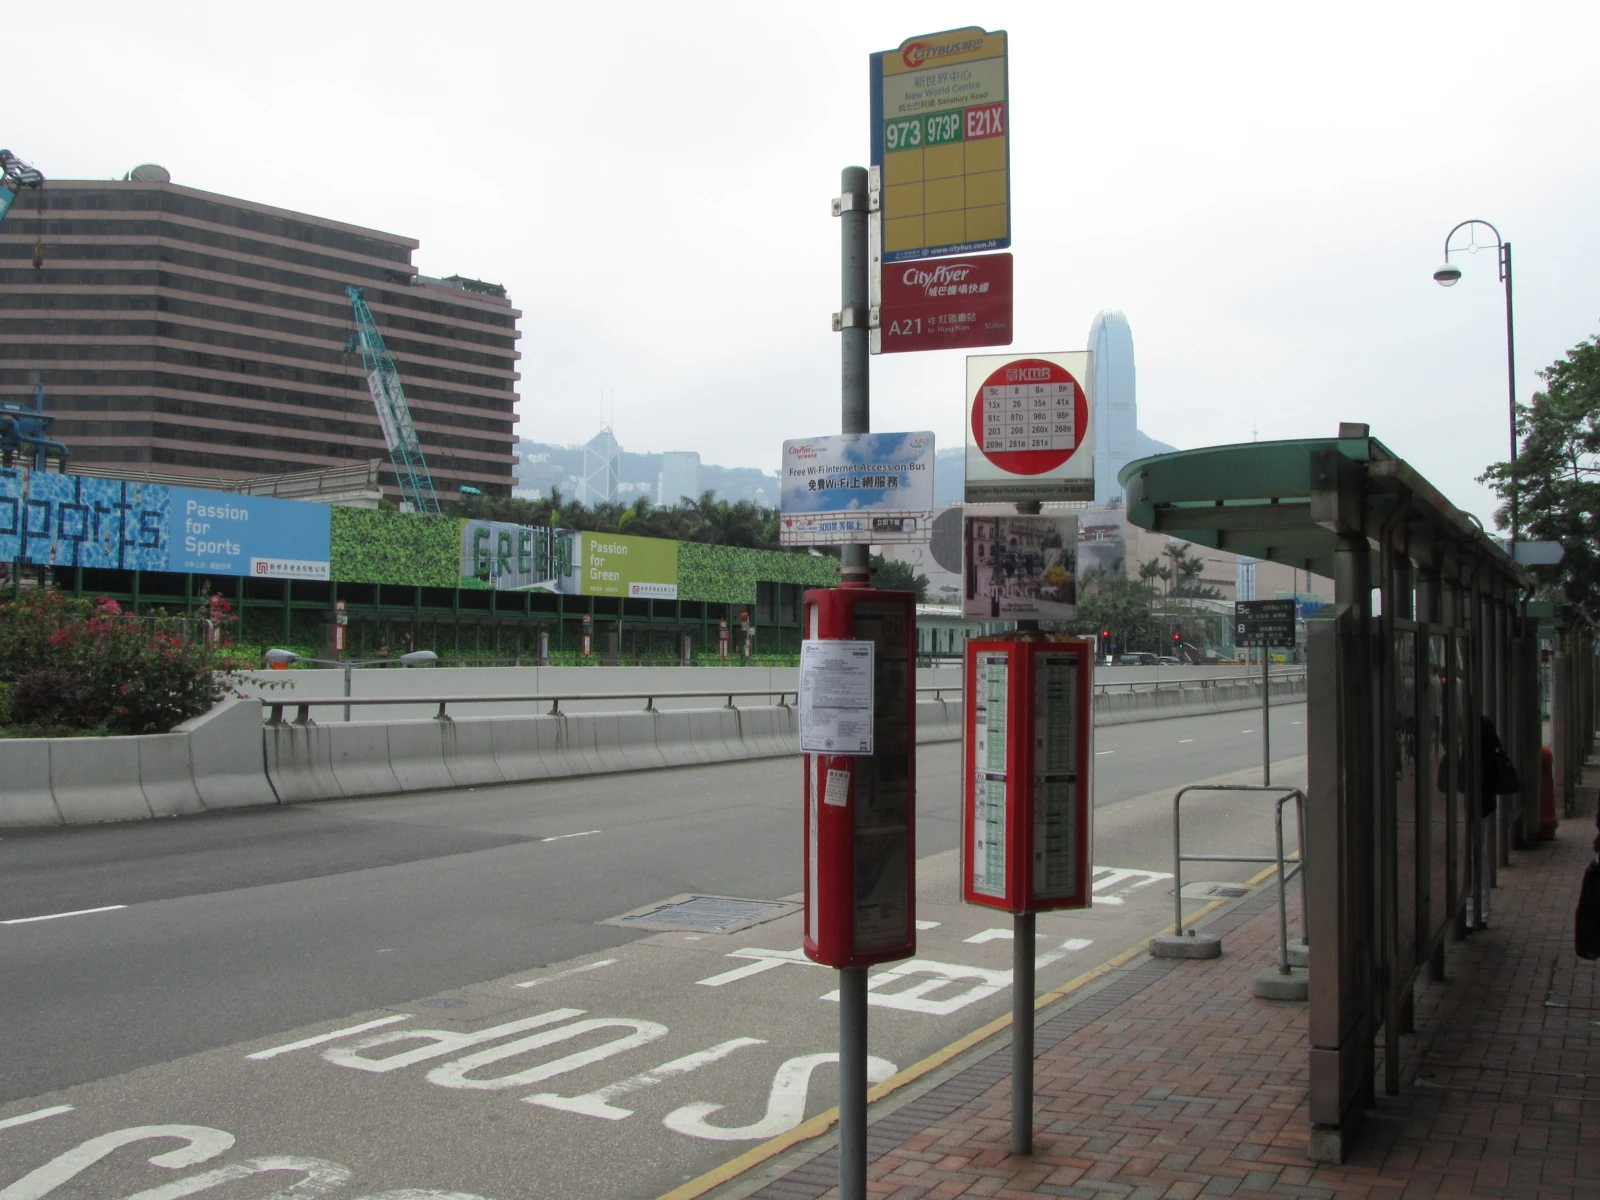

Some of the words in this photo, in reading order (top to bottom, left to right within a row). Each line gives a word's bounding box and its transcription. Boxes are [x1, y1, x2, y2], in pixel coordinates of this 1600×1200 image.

[914, 43, 963, 60] CITYBUS
[914, 70, 972, 88] 新世界中心
[905, 91, 923, 100] New
[925, 85, 950, 98] World
[952, 81, 981, 93] Centre
[937, 94, 969, 106] Salisbury
[970, 91, 988, 100] Road
[886, 120, 921, 149] 973
[927, 113, 960, 142] 973P
[967, 107, 1002, 137] E21X
[888, 318, 922, 336] A21
[984, 321, 1007, 330] Station
[1018, 367, 1051, 381] KMB
[1035, 386, 1044, 394] 8A
[1058, 385, 1067, 393] 8P
[988, 401, 1001, 409] 13X
[1012, 400, 1022, 408] 26
[1033, 399, 1047, 407] 35A
[1010, 413, 1024, 421] 87D
[1033, 412, 1047, 420] 98D
[1056, 411, 1070, 419] 98P
[988, 427, 1001, 435] 203
[1010, 426, 1024, 435] 208
[1031, 425, 1049, 433] 260X
[1054, 424, 1072, 433] 268B
[1008, 439, 1026, 448] 281B
[1031, 438, 1049, 447] 281X
[789, 467, 806, 476] Free
[807, 466, 825, 475] Wi-Fi
[825, 464, 857, 473] Internet
[860, 462, 892, 472] Access
[909, 462, 926, 471] Bus
[808, 475, 899, 491] 免費Wi-Fi上網服務
[186, 499, 249, 521] Passion
[184, 518, 211, 535] for
[184, 536, 241, 557] Sports
[472, 526, 573, 578] GREEN
[589, 540, 628, 555] Passion
[589, 553, 606, 567] for
[589, 567, 620, 581] Green
[1237, 623, 1246, 634] 8
[321, 1008, 898, 1141] STOP
